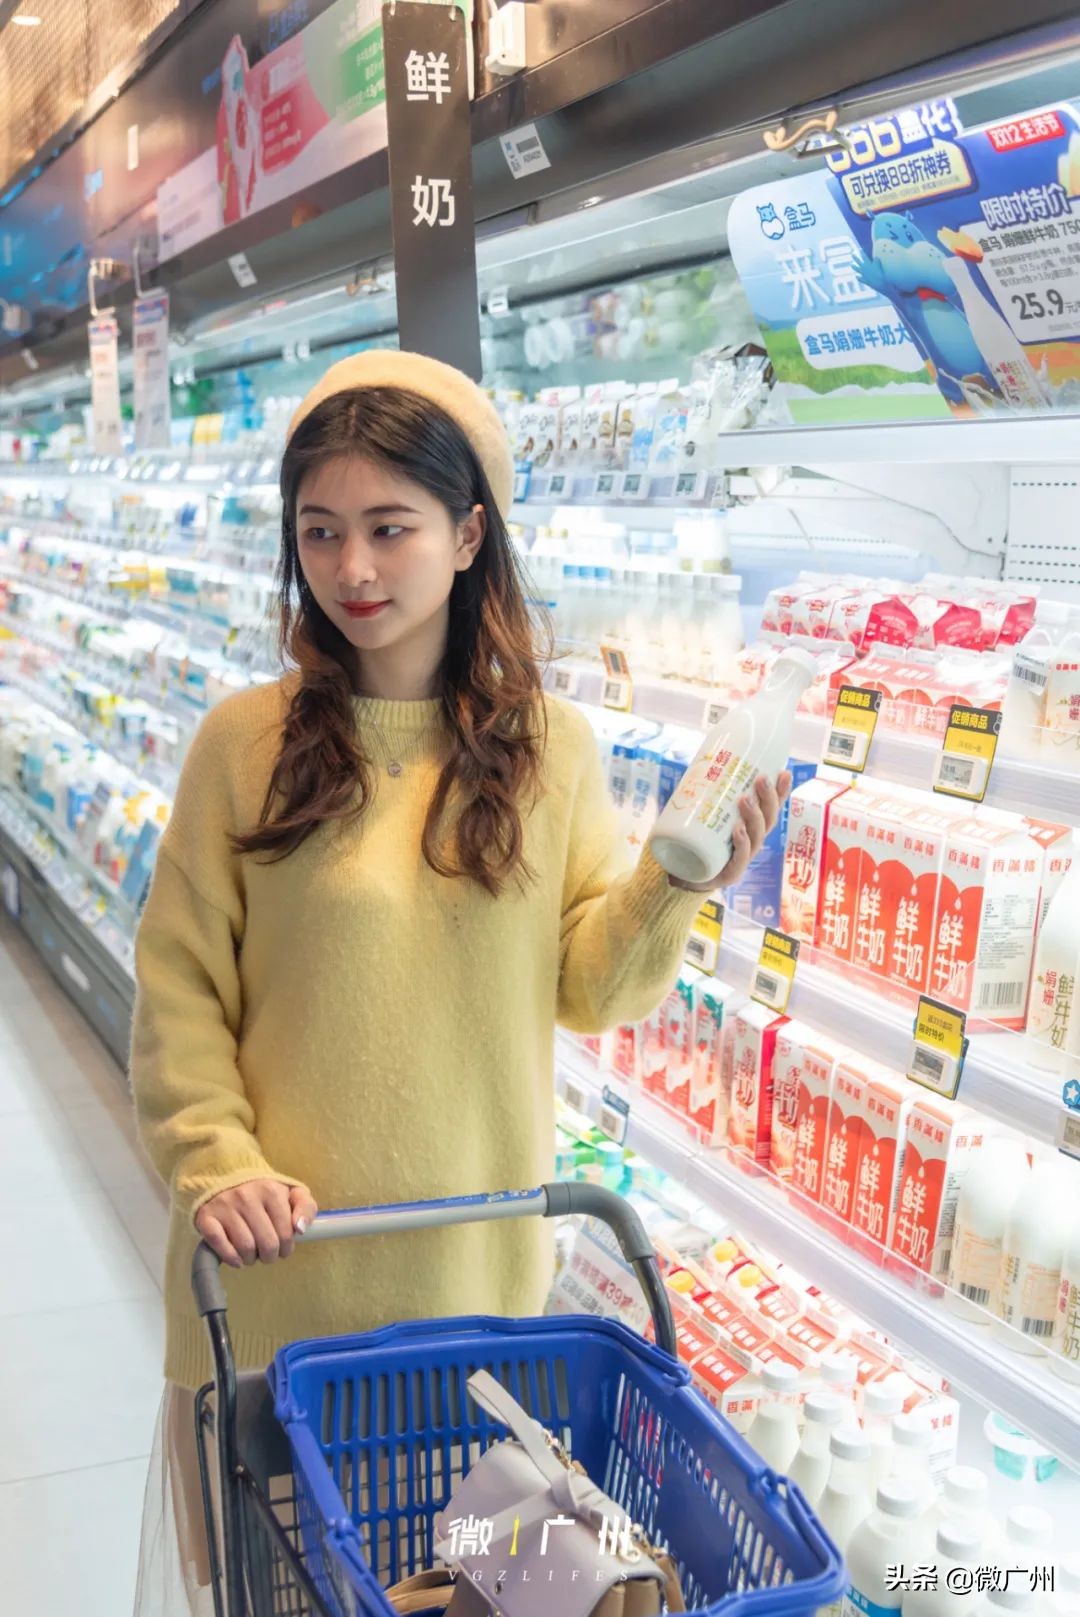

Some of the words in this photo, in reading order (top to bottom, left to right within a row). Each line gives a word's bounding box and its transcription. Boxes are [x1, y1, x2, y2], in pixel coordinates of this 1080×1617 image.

[850, 151, 952, 199] 可兑换88折神券
[784, 202, 816, 231] 盒马
[980, 183, 1069, 229] 限时特价
[1011, 289, 1063, 320] 25.9
[951, 709, 988, 730] 促销商品
